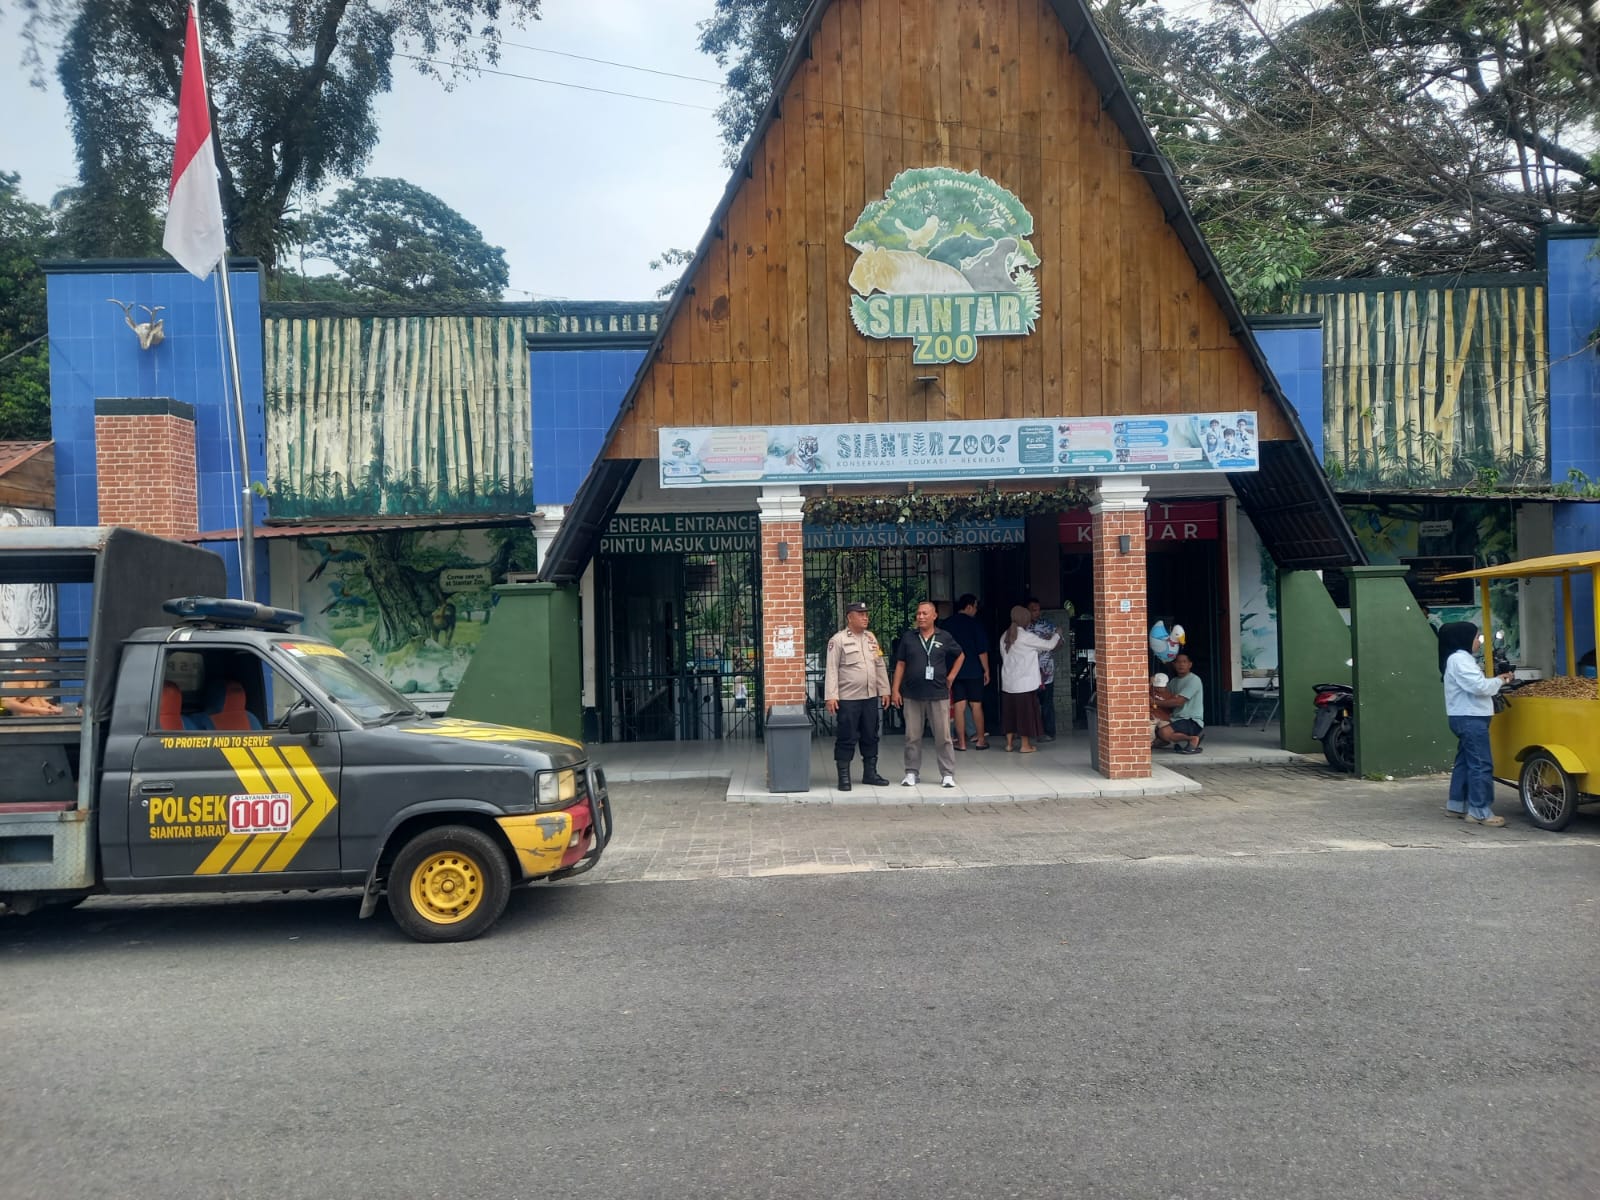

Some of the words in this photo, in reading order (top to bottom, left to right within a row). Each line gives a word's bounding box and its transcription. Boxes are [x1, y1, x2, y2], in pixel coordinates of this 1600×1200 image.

[897, 181, 930, 199] HEWAN
[934, 179, 984, 195] PEMATANG
[869, 296, 1021, 334] SIANTAR
[917, 335, 973, 361] ZOO
[836, 432, 944, 458] SIANTAR
[605, 517, 670, 533] ENERAL
[675, 515, 757, 532] ENTRANCE
[600, 538, 645, 552] PINTU
[651, 537, 704, 552] MASUK
[710, 536, 756, 551] UMUM
[807, 533, 845, 548] INTU
[852, 531, 910, 547] MASUK
[916, 528, 1025, 545] ROMBONGAN
[175, 736, 212, 748] PROTECT
[213, 736, 230, 748] AND
[231, 736, 241, 747] TO
[149, 795, 228, 824] POLSEK
[235, 801, 287, 826] 110
[150, 825, 192, 839] SIANTAR
[194, 824, 227, 838] BARAT
